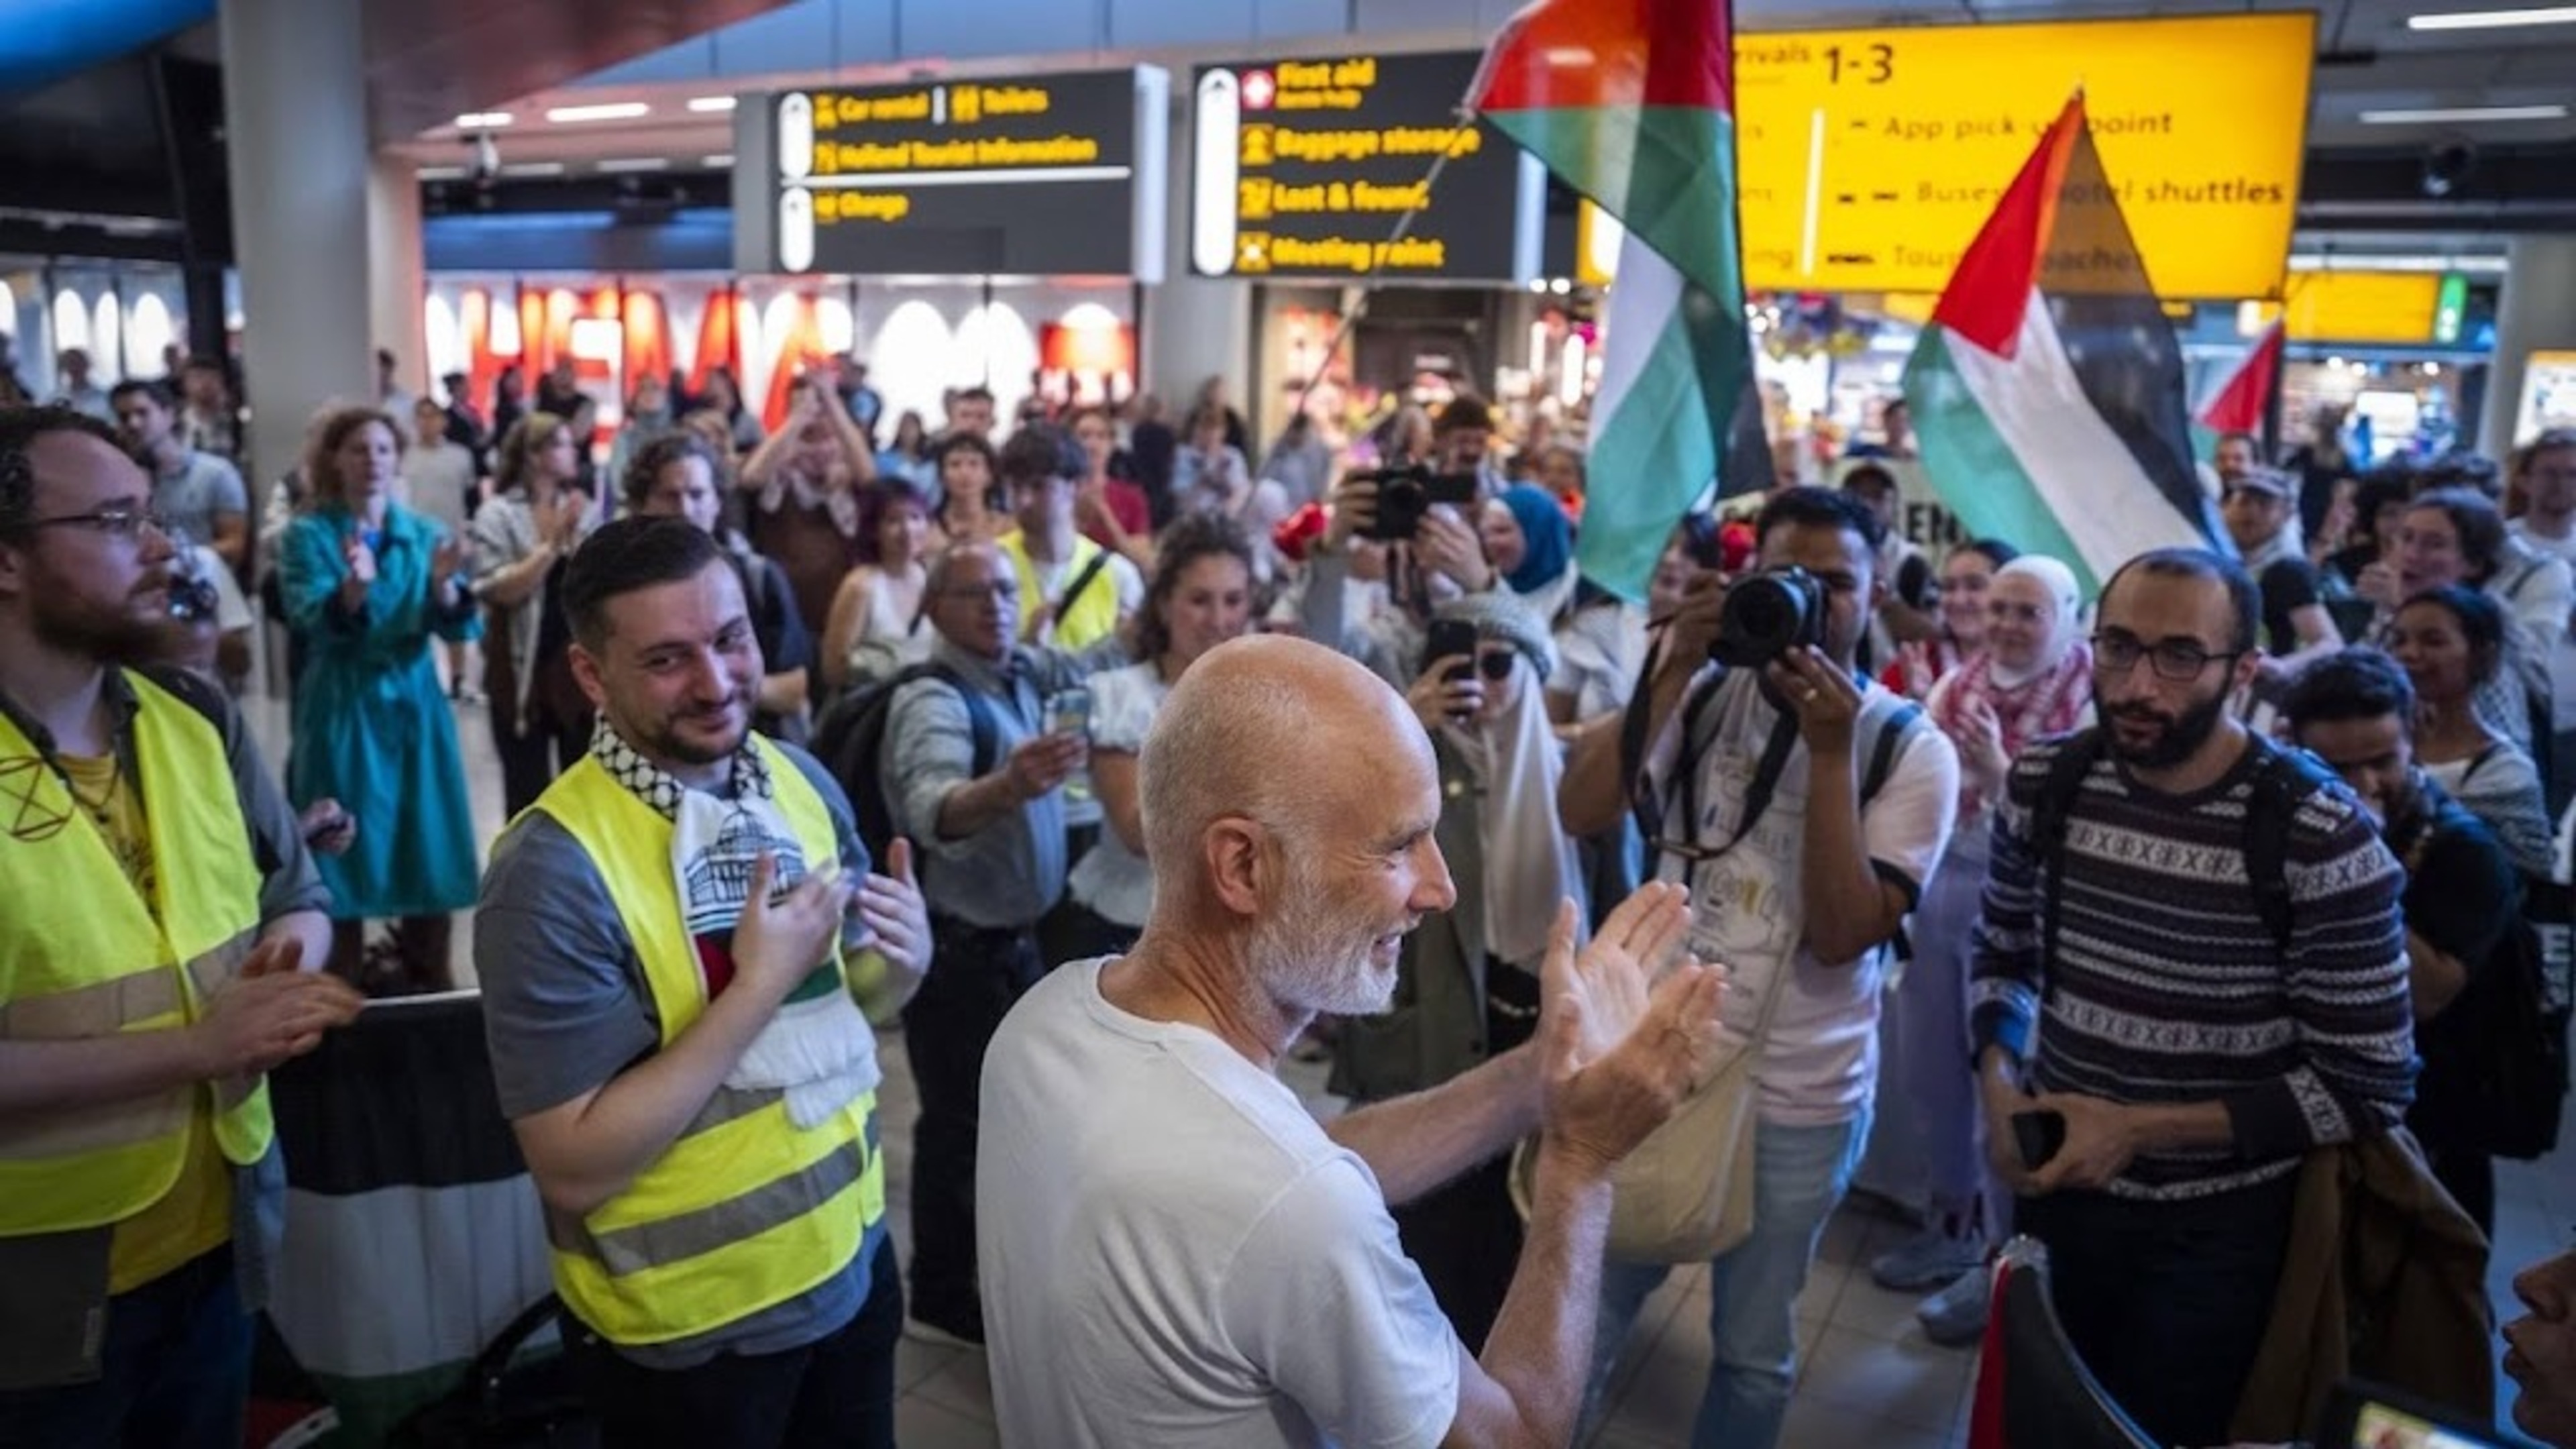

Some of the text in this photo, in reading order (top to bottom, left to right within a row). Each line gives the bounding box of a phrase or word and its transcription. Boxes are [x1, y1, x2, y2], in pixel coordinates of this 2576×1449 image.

[1823, 42, 1894, 85] 1-3
[1884, 115, 1943, 140] App
[1275, 129, 1380, 161] Baggage
[1273, 182, 1325, 211] Lost
[1328, 182, 1350, 210] &
[2145, 176, 2284, 203] shuttles
[1272, 236, 1371, 271] Meeting
